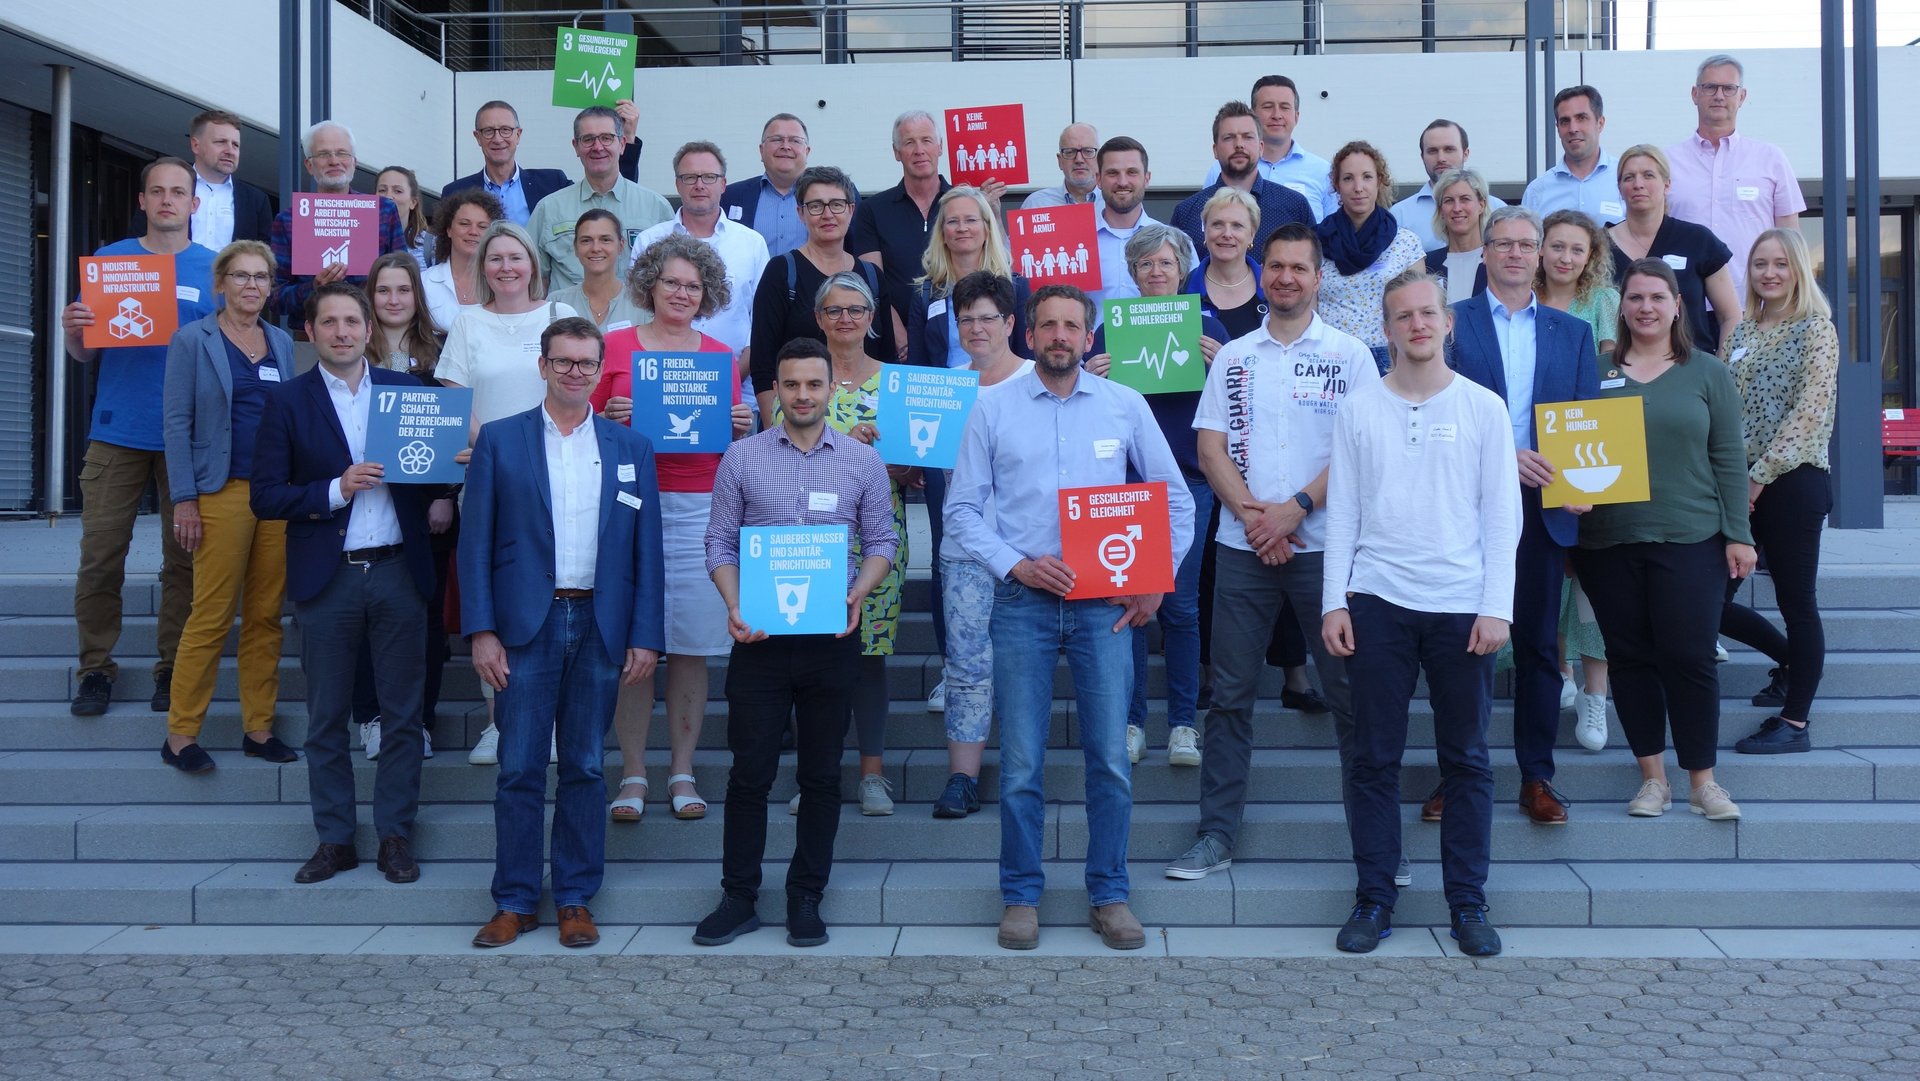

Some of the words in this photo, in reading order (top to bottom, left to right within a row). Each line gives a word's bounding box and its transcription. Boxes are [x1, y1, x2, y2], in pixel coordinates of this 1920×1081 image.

[564, 33, 572, 50] 3
[579, 34, 614, 46] GESUNDHEIT
[615, 38, 628, 48] UND
[578, 44, 621, 56] WOHLERGEHEN
[966, 112, 983, 121] KEINE
[953, 114, 960, 132] 1
[968, 122, 987, 131] ARMUT
[300, 198, 310, 216] 8
[314, 198, 376, 208] MENSCHENWÜRDIGE
[314, 208, 336, 217] ARBEIT
[337, 209, 350, 218] UND
[1032, 212, 1051, 223] KEINE
[314, 218, 360, 228] WIRTSCHAFTS-
[1016, 216, 1024, 235] 1
[1033, 222, 1056, 234] ARMUT
[314, 228, 350, 237] WACHSTUM
[86, 262, 98, 283] 9
[103, 272, 144, 282] INNOVATION
[144, 272, 160, 281] UND
[104, 282, 160, 294] INFRASTRUKTUR
[1130, 302, 1174, 314] GESUNDHEIT
[1174, 301, 1190, 311] UND
[1112, 306, 1123, 327] 3
[1130, 313, 1183, 326] WOHLERGEHEN
[638, 358, 658, 380] 16
[663, 358, 695, 369] FRIEDEN,
[663, 370, 720, 381] GERECHTIGKEIT
[1294, 363, 1341, 378] CAMP
[888, 371, 900, 394] 6
[908, 372, 945, 385] SAUBERES
[946, 376, 976, 388] WASSER
[663, 382, 679, 393] UND
[680, 382, 708, 393] STARKE
[906, 384, 922, 395] UND
[922, 386, 956, 398] SANITÄR-
[378, 392, 397, 413] 17
[402, 392, 439, 403] PARTNER-
[662, 394, 717, 405] INSTITUTIONEN
[906, 396, 962, 410] EINRICHTUNGEN
[1226, 366, 1244, 430] GUARD
[400, 404, 440, 414] SCHAFTEN
[1565, 408, 1584, 419] KEIN
[400, 416, 415, 426] ZUR
[416, 416, 463, 426] ERREICHUNG
[1545, 410, 1557, 433] 2
[1566, 420, 1598, 432] HUNGER
[398, 426, 413, 437] DER
[414, 428, 435, 438] ZIELE
[1089, 490, 1153, 505] GESCHLECHTER-
[1068, 496, 1080, 520] 5
[1090, 505, 1135, 518] GLEICHHEIT
[770, 534, 810, 544] SAUBERES
[811, 532, 844, 544] WASSER
[750, 534, 762, 558] 6
[770, 547, 786, 557] UND
[787, 546, 824, 557] SANITÄR-
[770, 559, 832, 570] EINRICHTUNGEN
